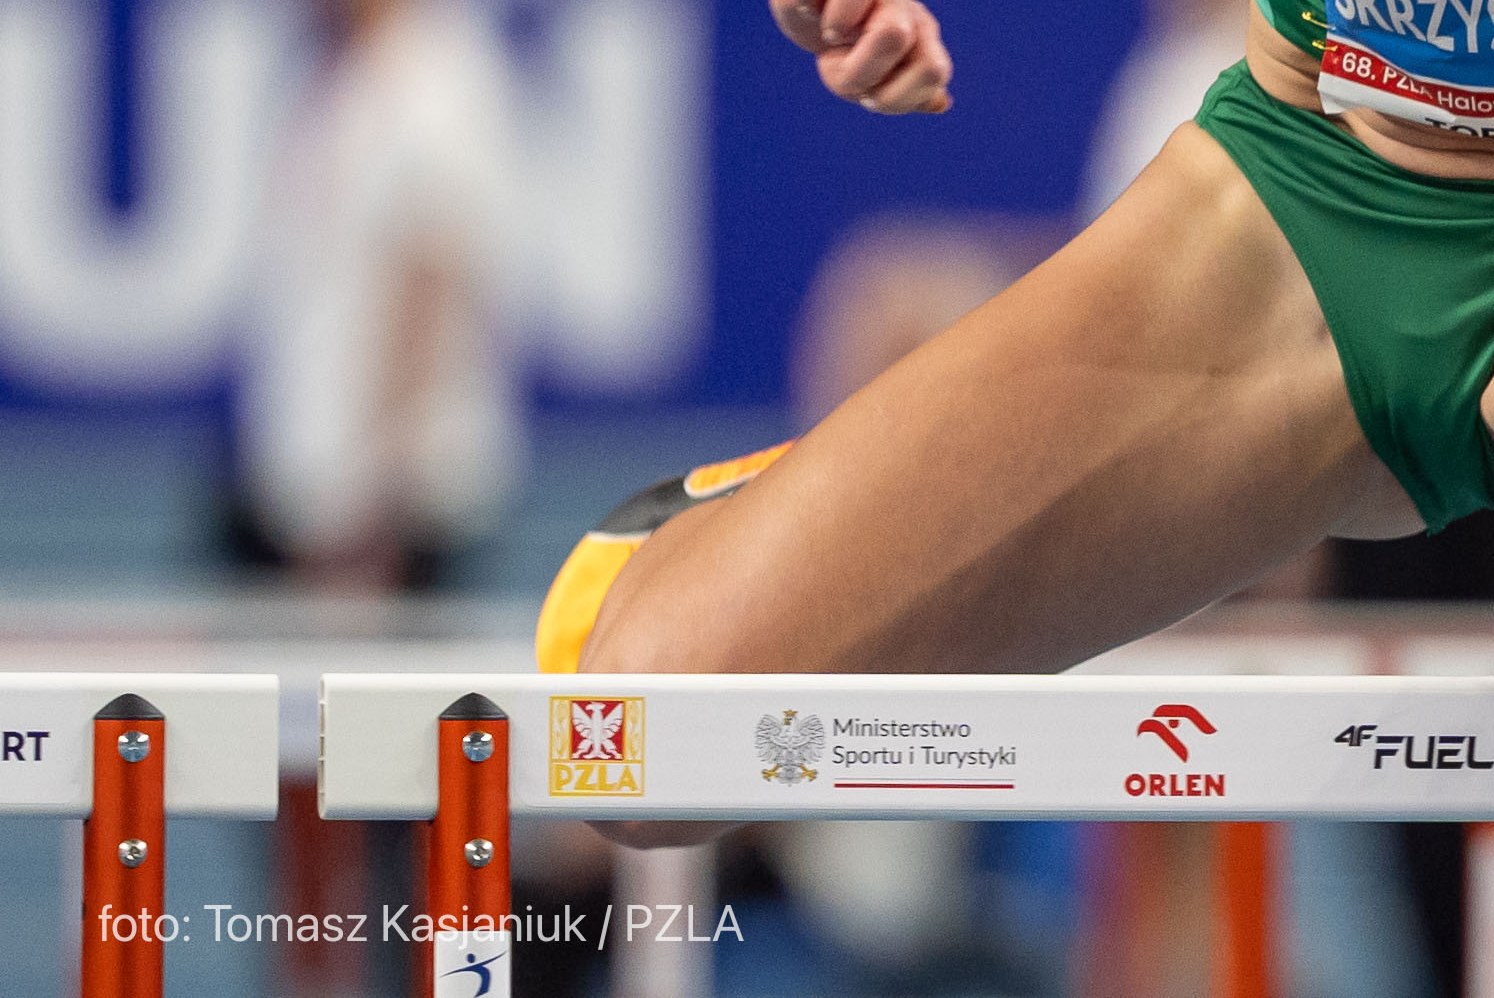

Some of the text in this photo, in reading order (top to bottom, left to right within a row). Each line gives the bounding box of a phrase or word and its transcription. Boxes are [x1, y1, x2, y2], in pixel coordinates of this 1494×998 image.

[1341, 52, 1376, 81] 68.
[833, 718, 971, 738] Ministerstwo
[832, 745, 1016, 769] Sportu i Turystyki
[554, 764, 640, 793] PZLA
[1124, 774, 1226, 797] ORLEN
